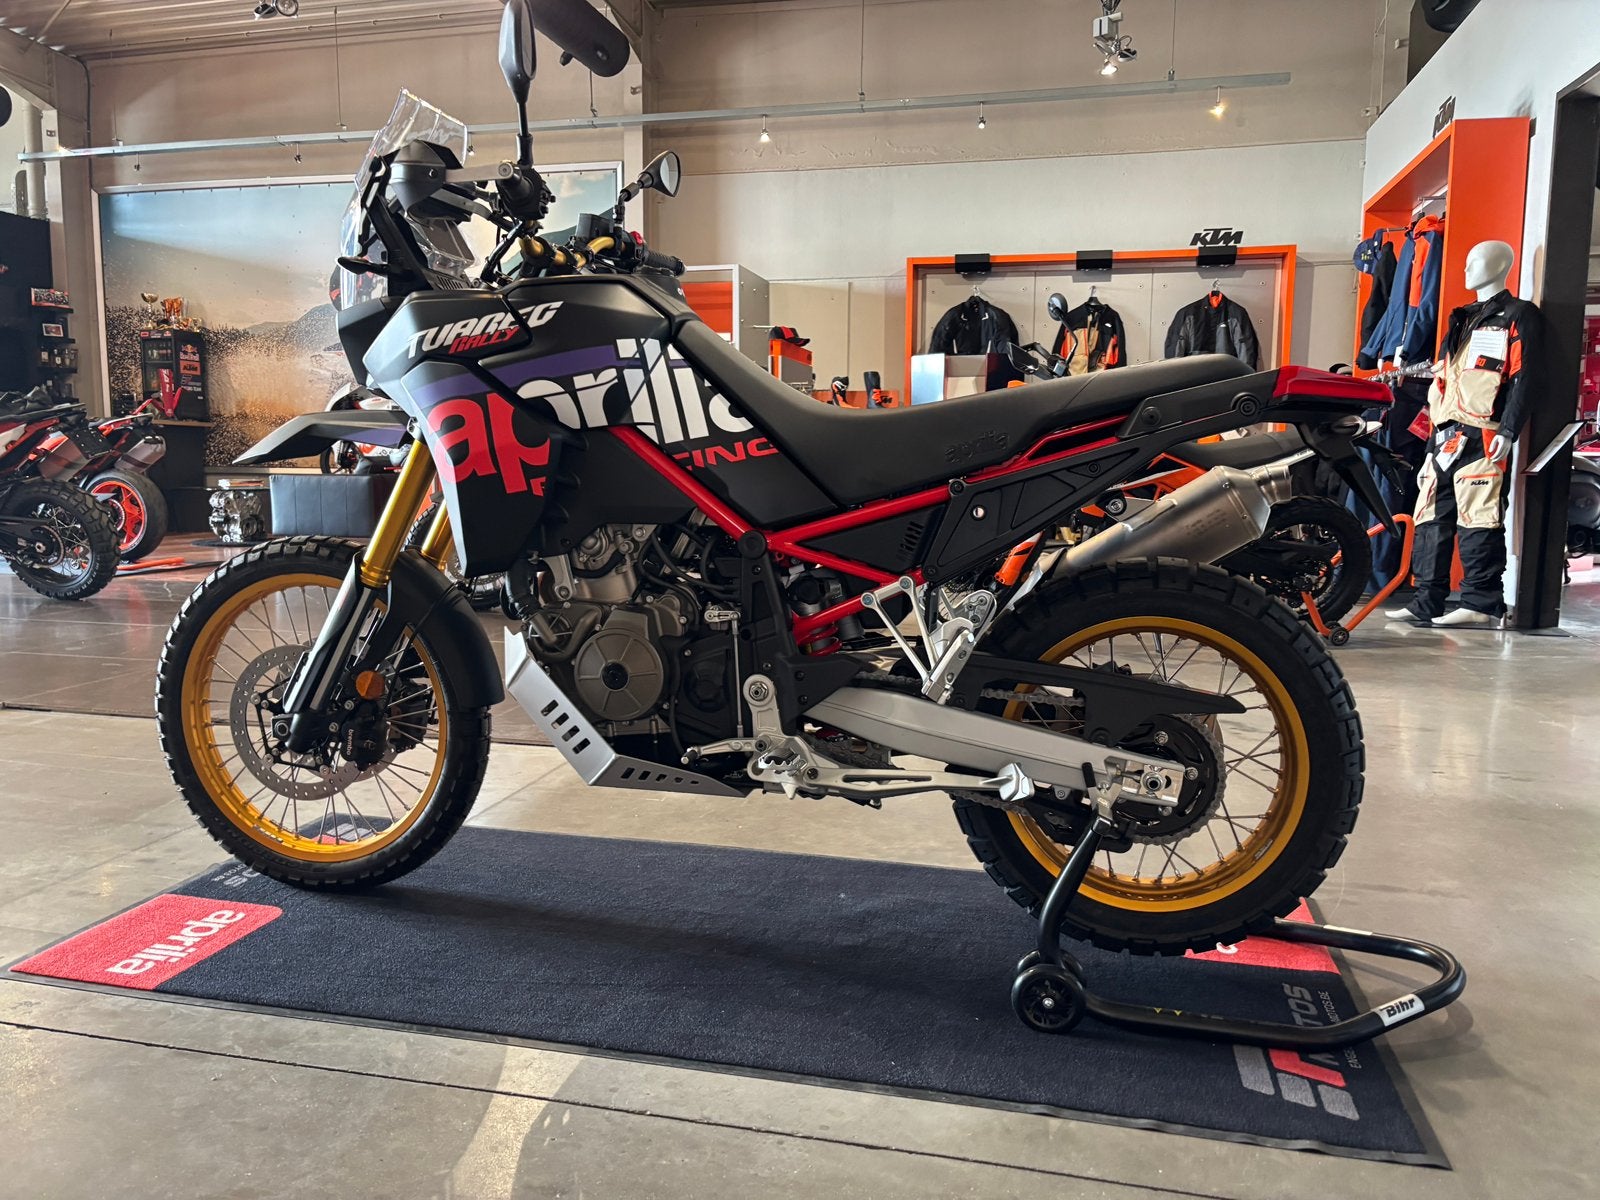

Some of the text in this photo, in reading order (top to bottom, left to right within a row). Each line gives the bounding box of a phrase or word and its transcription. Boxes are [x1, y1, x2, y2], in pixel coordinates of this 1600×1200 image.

[1432, 95, 1456, 139] KTM
[1189, 227, 1244, 246] KTM
[407, 301, 565, 359] TUAREG
[448, 326, 521, 355] RALLY
[346, 729, 355, 756] brembo
[104, 909, 247, 975] aprilia
[1379, 997, 1417, 1019] Bihr
